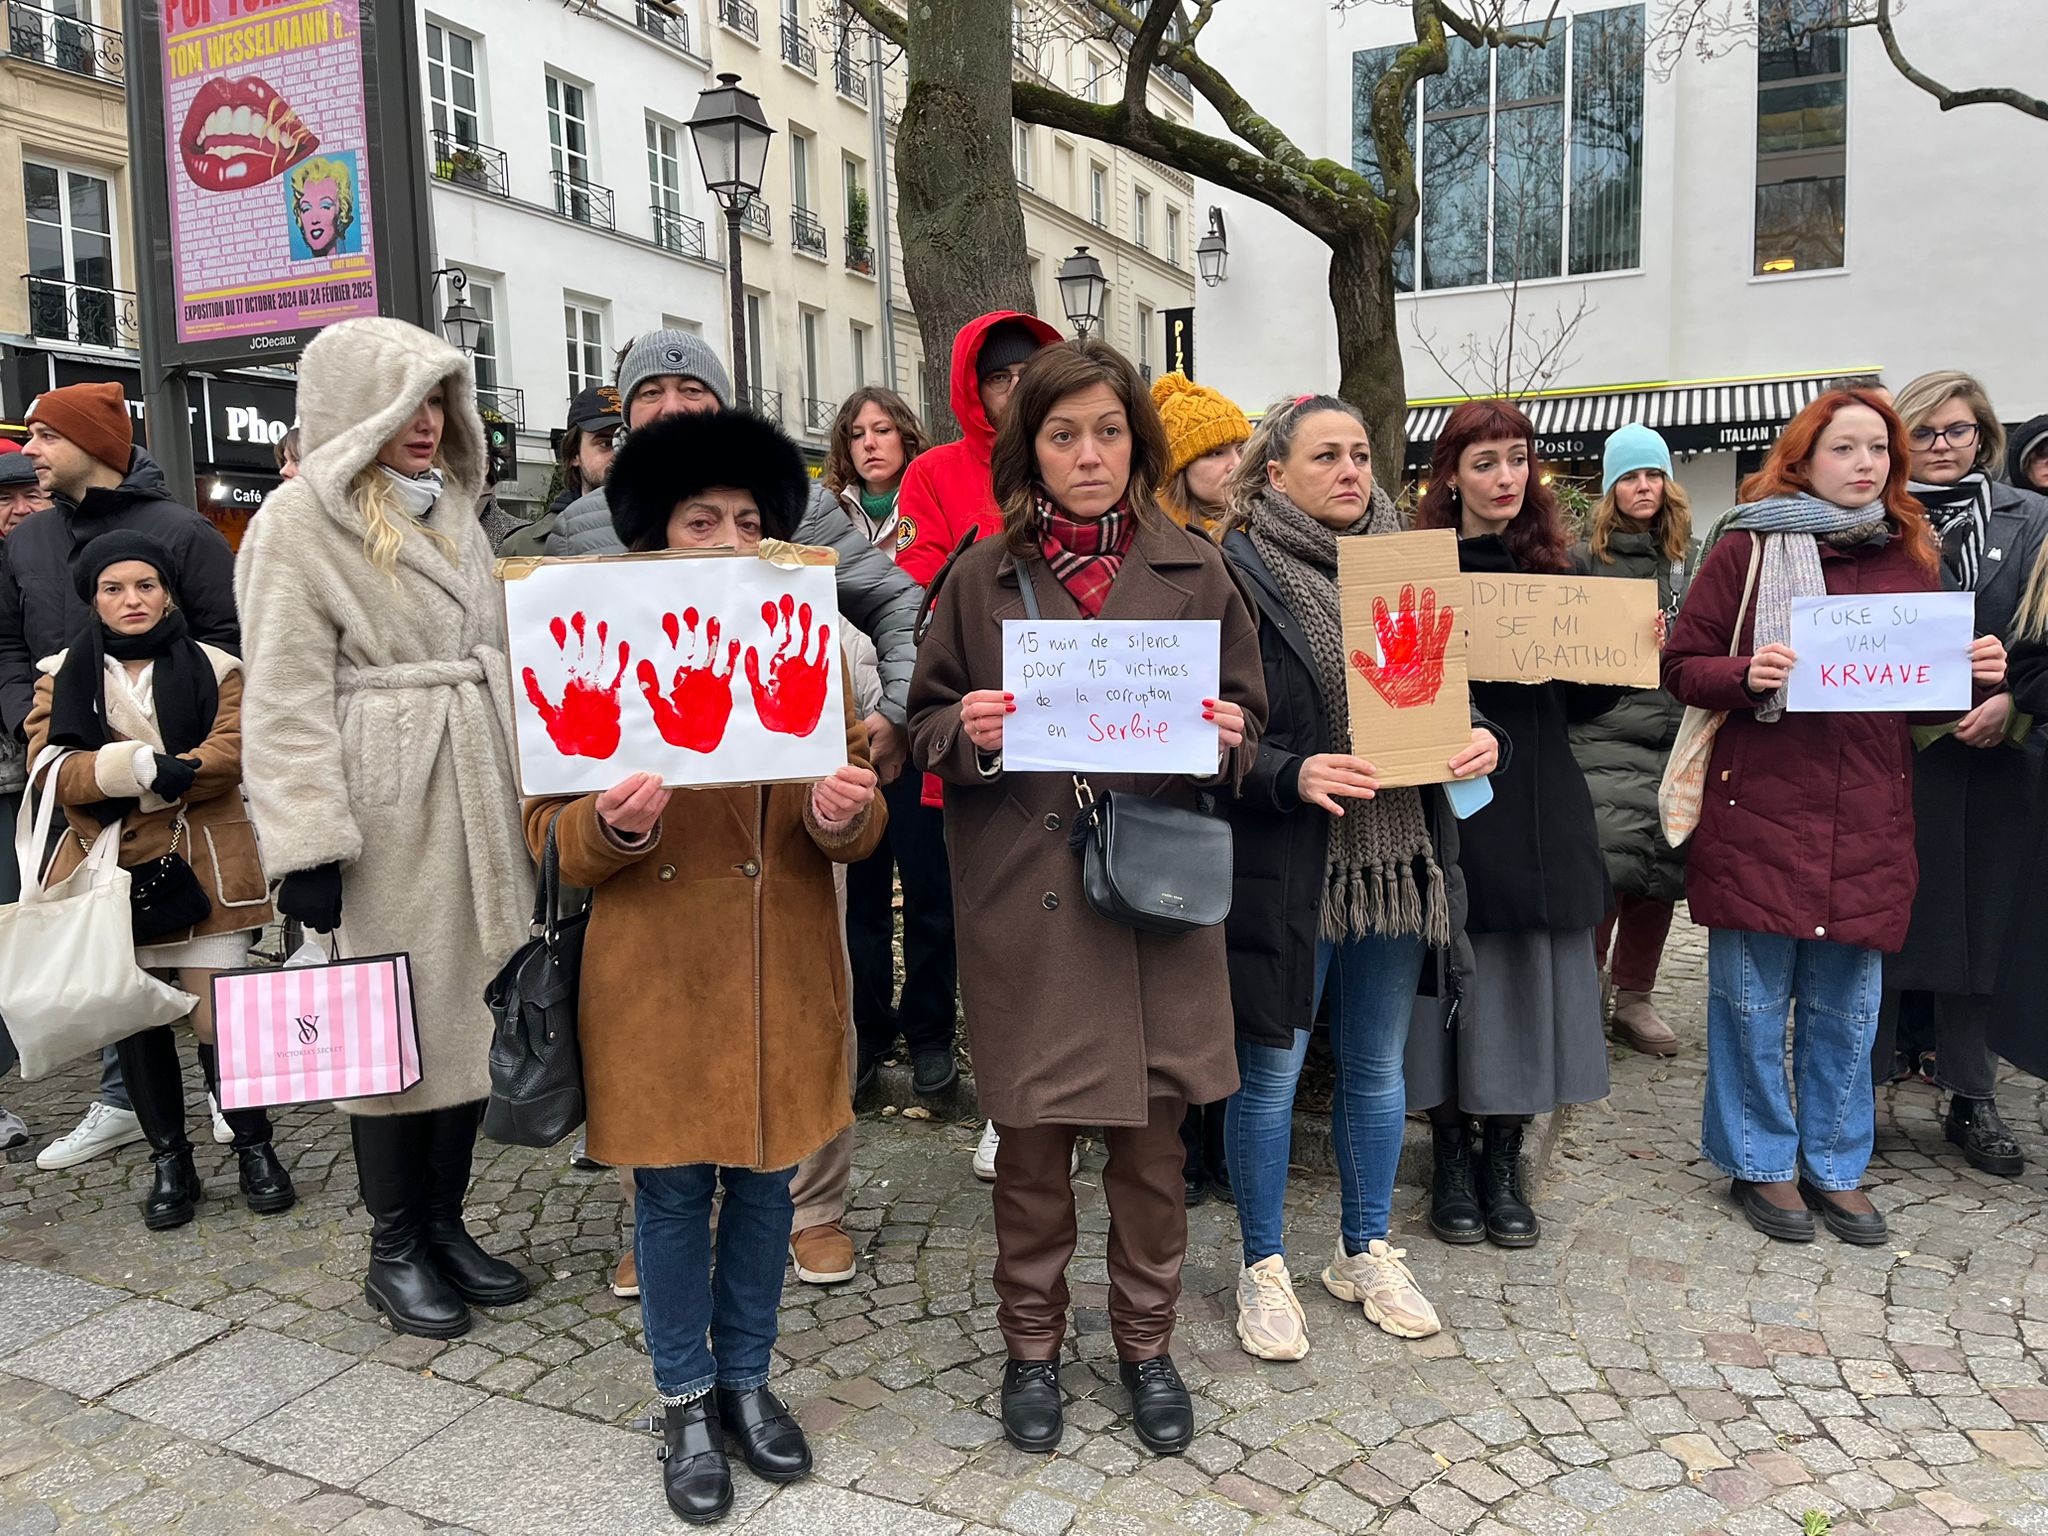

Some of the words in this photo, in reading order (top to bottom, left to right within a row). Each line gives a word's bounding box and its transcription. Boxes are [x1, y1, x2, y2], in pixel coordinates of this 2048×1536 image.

[168, 41, 204, 80] TOM
[206, 9, 328, 70] WESSELMANN
[184, 300, 225, 321] EXPOSITION
[225, 299, 236, 317] DU
[236, 298, 244, 315] 17
[244, 294, 277, 314] OCTOBRE
[277, 291, 297, 309] 2024
[298, 289, 309, 306] AU
[310, 287, 321, 304] 24
[321, 282, 351, 303] FÉVRIER
[351, 281, 373, 299] 2025
[250, 334, 297, 350] JCDecaux
[1534, 438, 1584, 454] Posto
[1720, 426, 1769, 443] ITALIAN
[233, 488, 262, 503] Café
[1471, 579, 1546, 607] IDITE
[1558, 585, 1591, 606] DA
[1496, 616, 1536, 638] SE
[1553, 615, 1578, 637] MI
[1892, 605, 1918, 626] SU
[1018, 632, 1039, 653] 15
[1049, 637, 1079, 651] min
[1091, 632, 1108, 648] de
[1128, 631, 1180, 652] silence
[1512, 632, 1638, 672] VRATIMO!
[1846, 633, 1887, 654] VAM
[1023, 661, 1066, 688] pour
[1088, 658, 1107, 678] 15
[1125, 657, 1189, 677] victimes
[1821, 663, 1931, 688] KRVAVE
[1036, 689, 1052, 707] de
[1076, 687, 1089, 703] la
[1106, 686, 1172, 709] corruption
[1047, 723, 1067, 738] en
[1087, 712, 1169, 743] Serbie
[317, 1046, 344, 1054] SECRET
